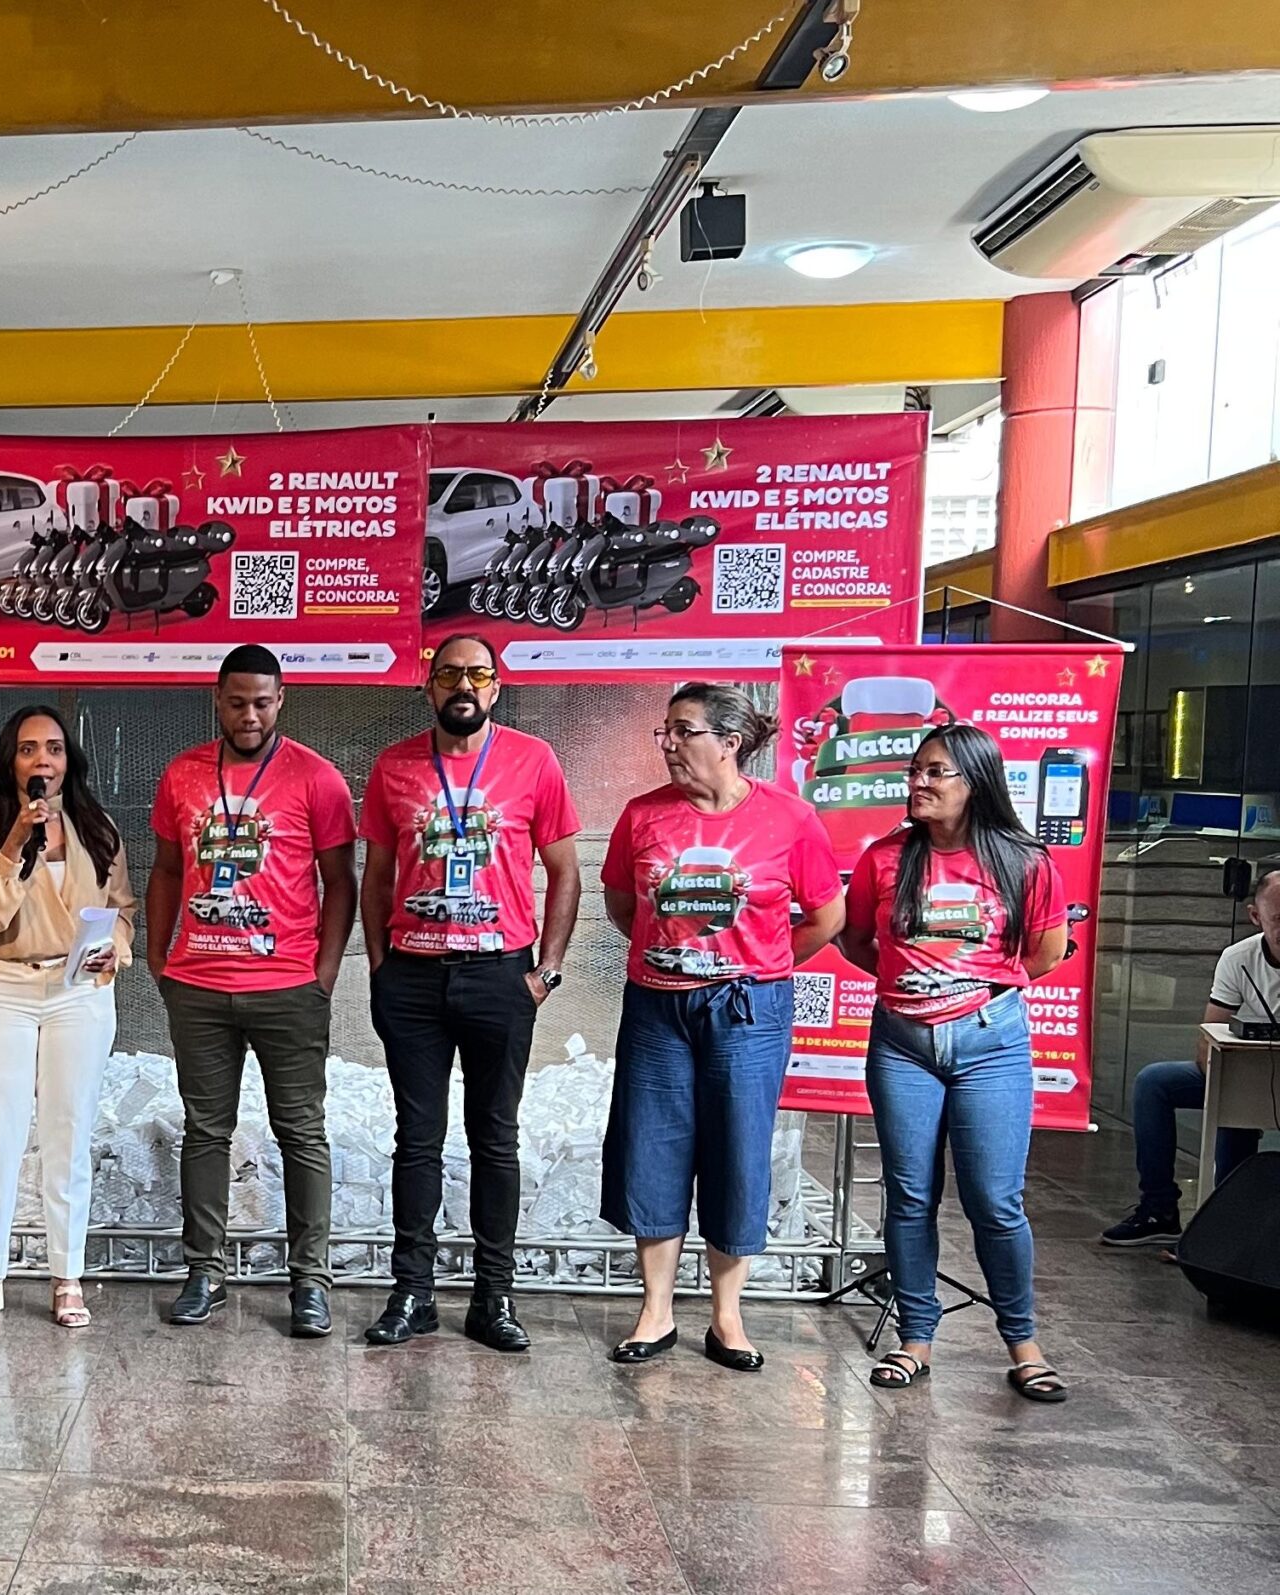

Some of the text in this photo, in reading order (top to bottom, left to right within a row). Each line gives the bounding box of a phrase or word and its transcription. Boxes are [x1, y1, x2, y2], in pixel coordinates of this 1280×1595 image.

[756, 462, 891, 483] 2 RENAULT
[269, 471, 399, 490] 2 RENAULT
[690, 485, 889, 509] KWID E 5 MOTOS
[206, 495, 397, 515] KWID E 5 MOTOS
[755, 507, 888, 530] ELÉTRICAS
[269, 515, 396, 538] ELÉTRICAS
[792, 550, 860, 565] COMPRE,
[305, 558, 370, 573] COMPRE,
[792, 566, 869, 580] CADASTRE
[304, 574, 379, 587] CADASTRE
[791, 582, 891, 596] E CONCORRA:
[304, 590, 400, 603] E CONCORRA:
[990, 693, 1083, 706] CONCORRA
[972, 710, 1099, 723] E REALIZE SEUS
[1000, 727, 1068, 739] SONHOS
[1008, 771, 1028, 782] 50
[813, 784, 842, 803] de
[209, 824, 249, 838] Naal
[200, 846, 258, 860] de Prmios
[670, 875, 723, 890] Natal
[661, 900, 731, 912] de Prêmios
[923, 908, 970, 922] Natal
[221, 936, 249, 945] KWID
[446, 934, 477, 943] KWID
[839, 1006, 846, 1017] E
[1026, 1003, 1079, 1019] OTOS
[806, 1037, 821, 1046] DE
[1045, 1050, 1076, 1061] 16/01
